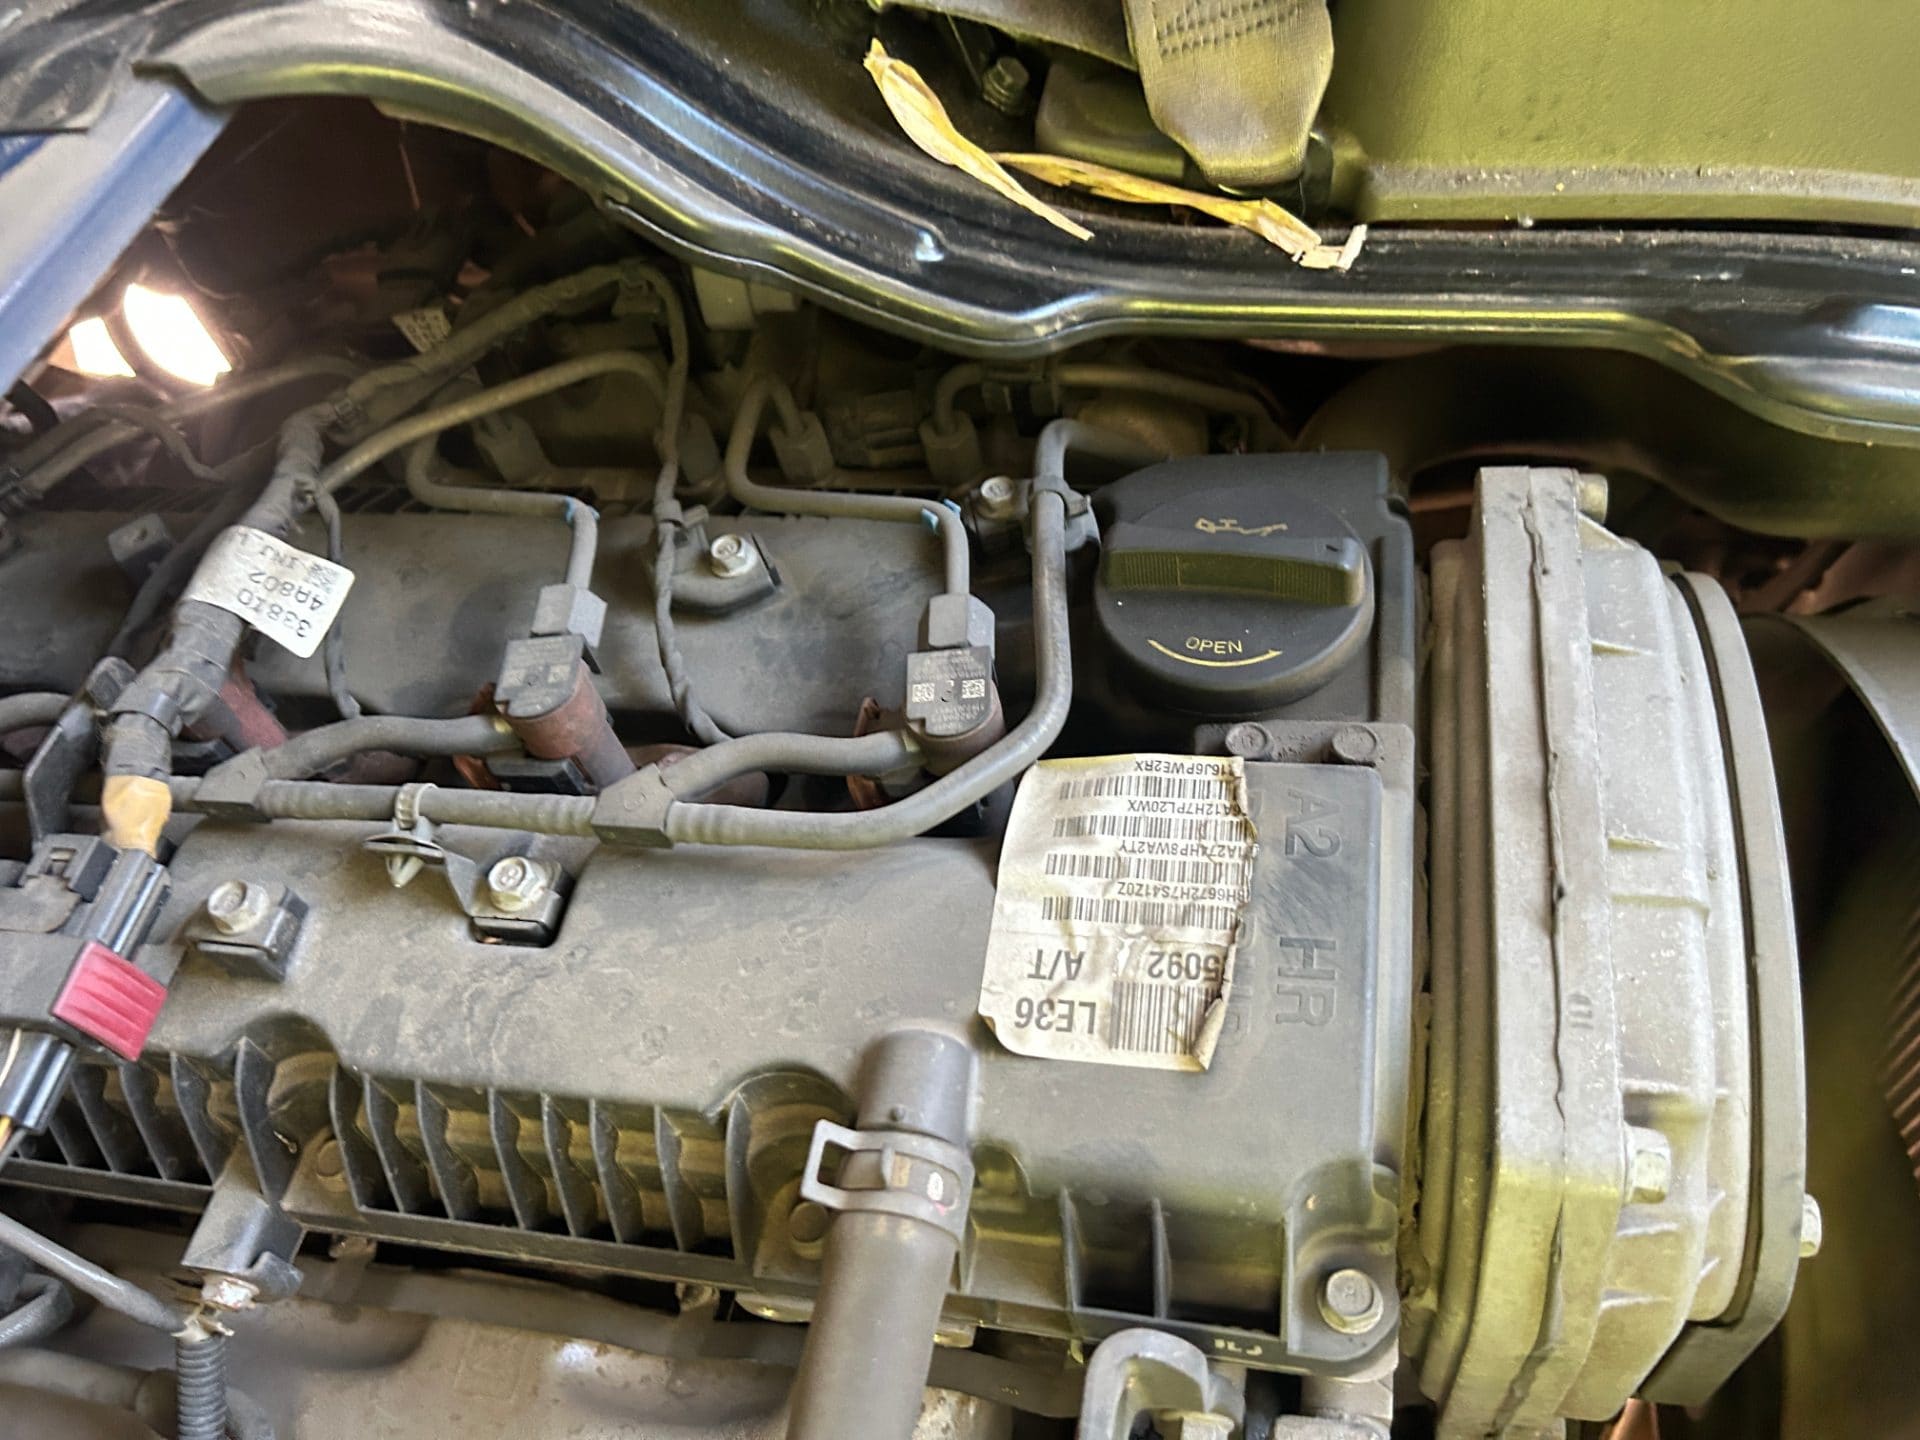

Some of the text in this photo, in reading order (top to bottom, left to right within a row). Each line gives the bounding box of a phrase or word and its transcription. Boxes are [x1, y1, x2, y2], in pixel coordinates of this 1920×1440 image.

[1185, 636, 1243, 654] OPEN
[1275, 787, 1342, 1026] A2 HR
[1026, 948, 1221, 982] 5092 A/T
[1013, 996, 1097, 1035] LE36
